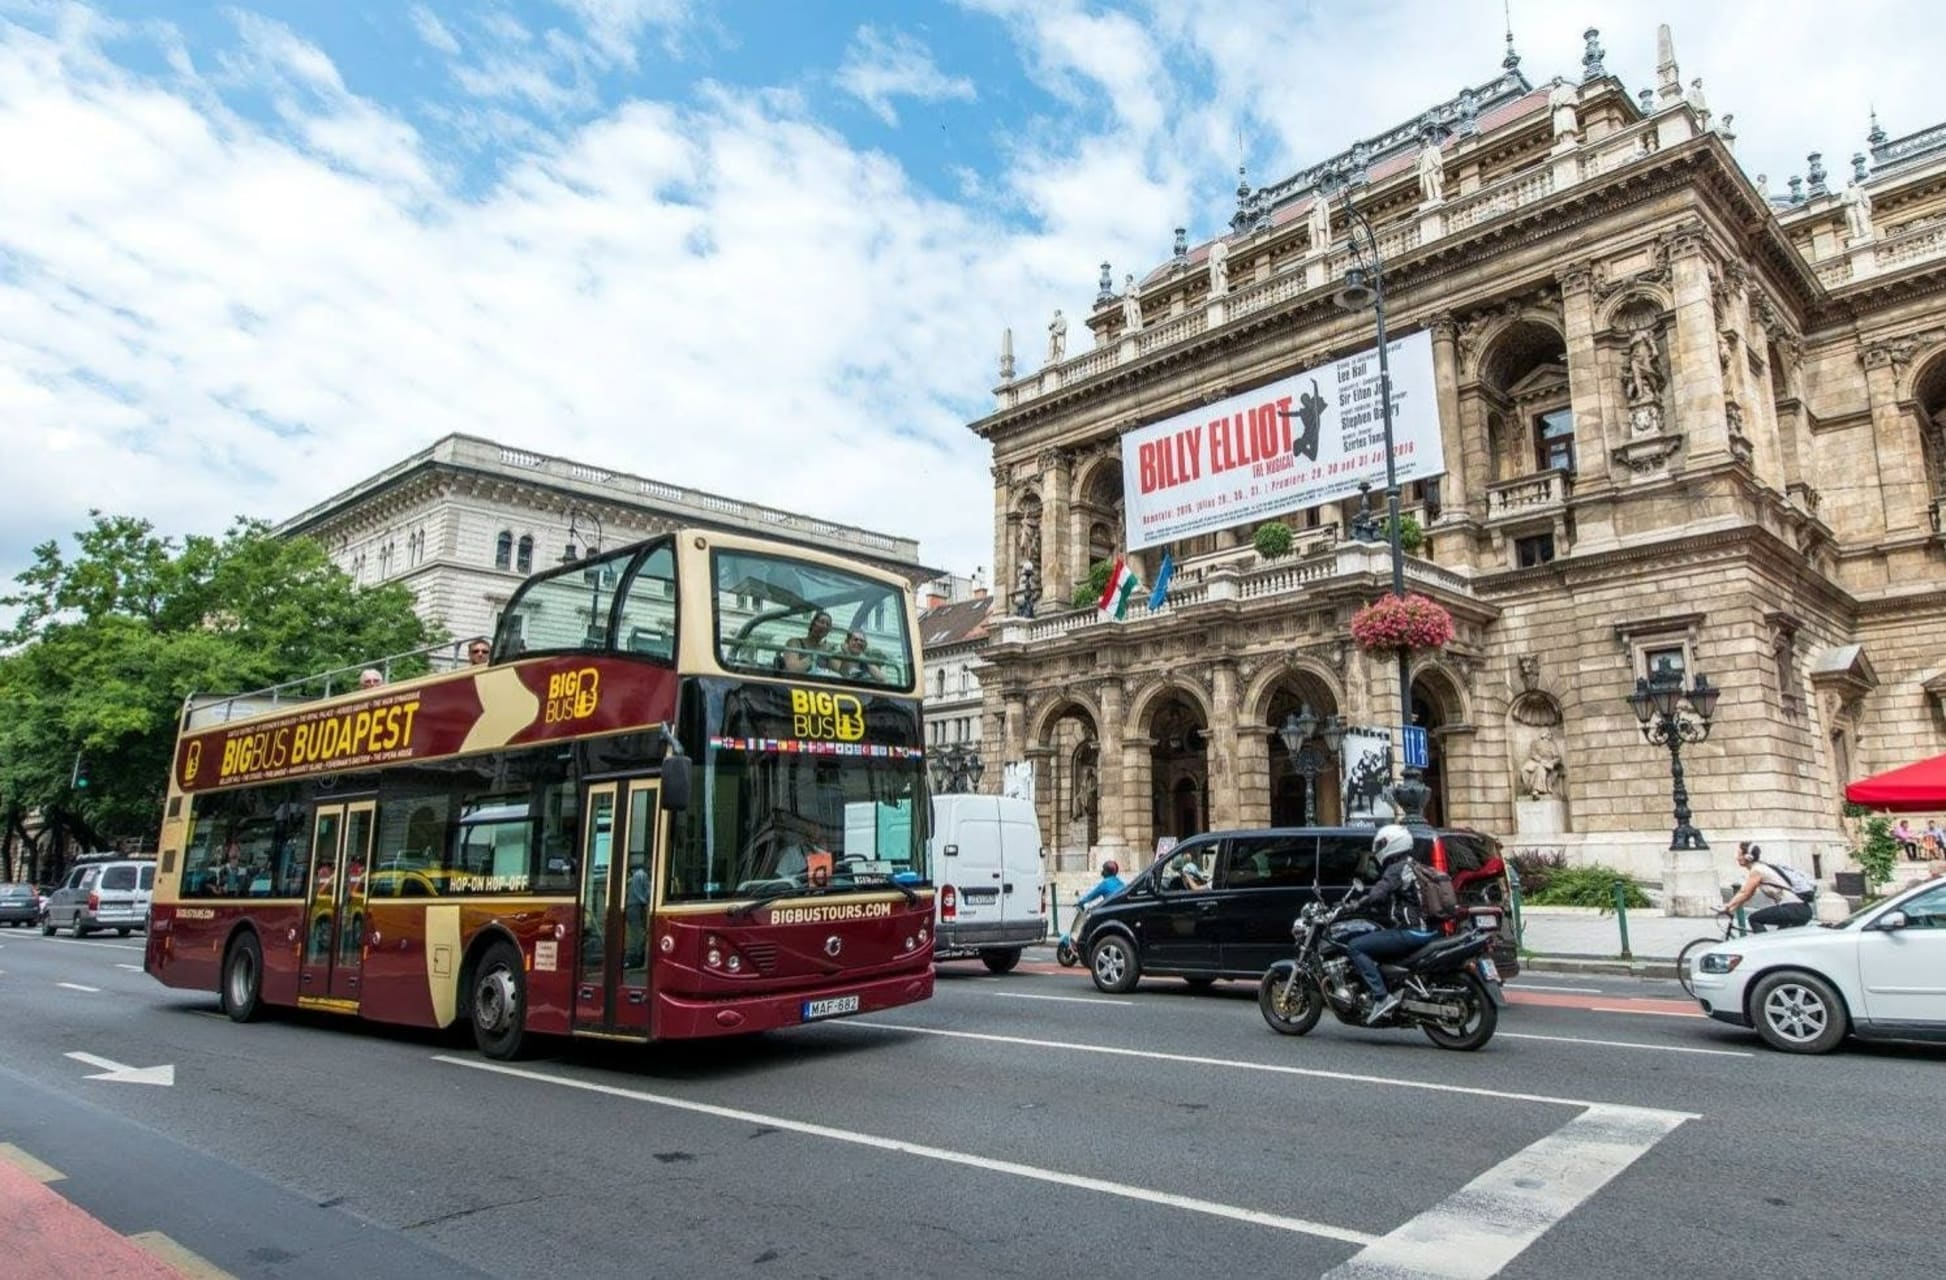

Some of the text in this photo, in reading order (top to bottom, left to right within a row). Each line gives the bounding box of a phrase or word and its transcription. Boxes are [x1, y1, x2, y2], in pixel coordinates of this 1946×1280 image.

[1337, 370, 1350, 384] Lee
[1352, 362, 1367, 379] Hall
[1340, 393, 1351, 407] Sir
[1353, 387, 1372, 402] Elton
[1341, 411, 1372, 430] Stephen
[1374, 403, 1399, 420] Dary
[1139, 396, 1293, 495] BILLY ELLIOT
[1252, 454, 1294, 479] THE MUSICAL
[1340, 457, 1355, 473] and
[548, 671, 577, 699] BIG
[545, 697, 574, 723] BUS
[791, 689, 833, 715] BIG
[291, 701, 420, 764] BUDAPEST
[794, 714, 835, 739] BUS
[449, 874, 528, 892] HOP-ON HOP-OFF
[771, 902, 892, 926] BIGBUSTOURS.COM
